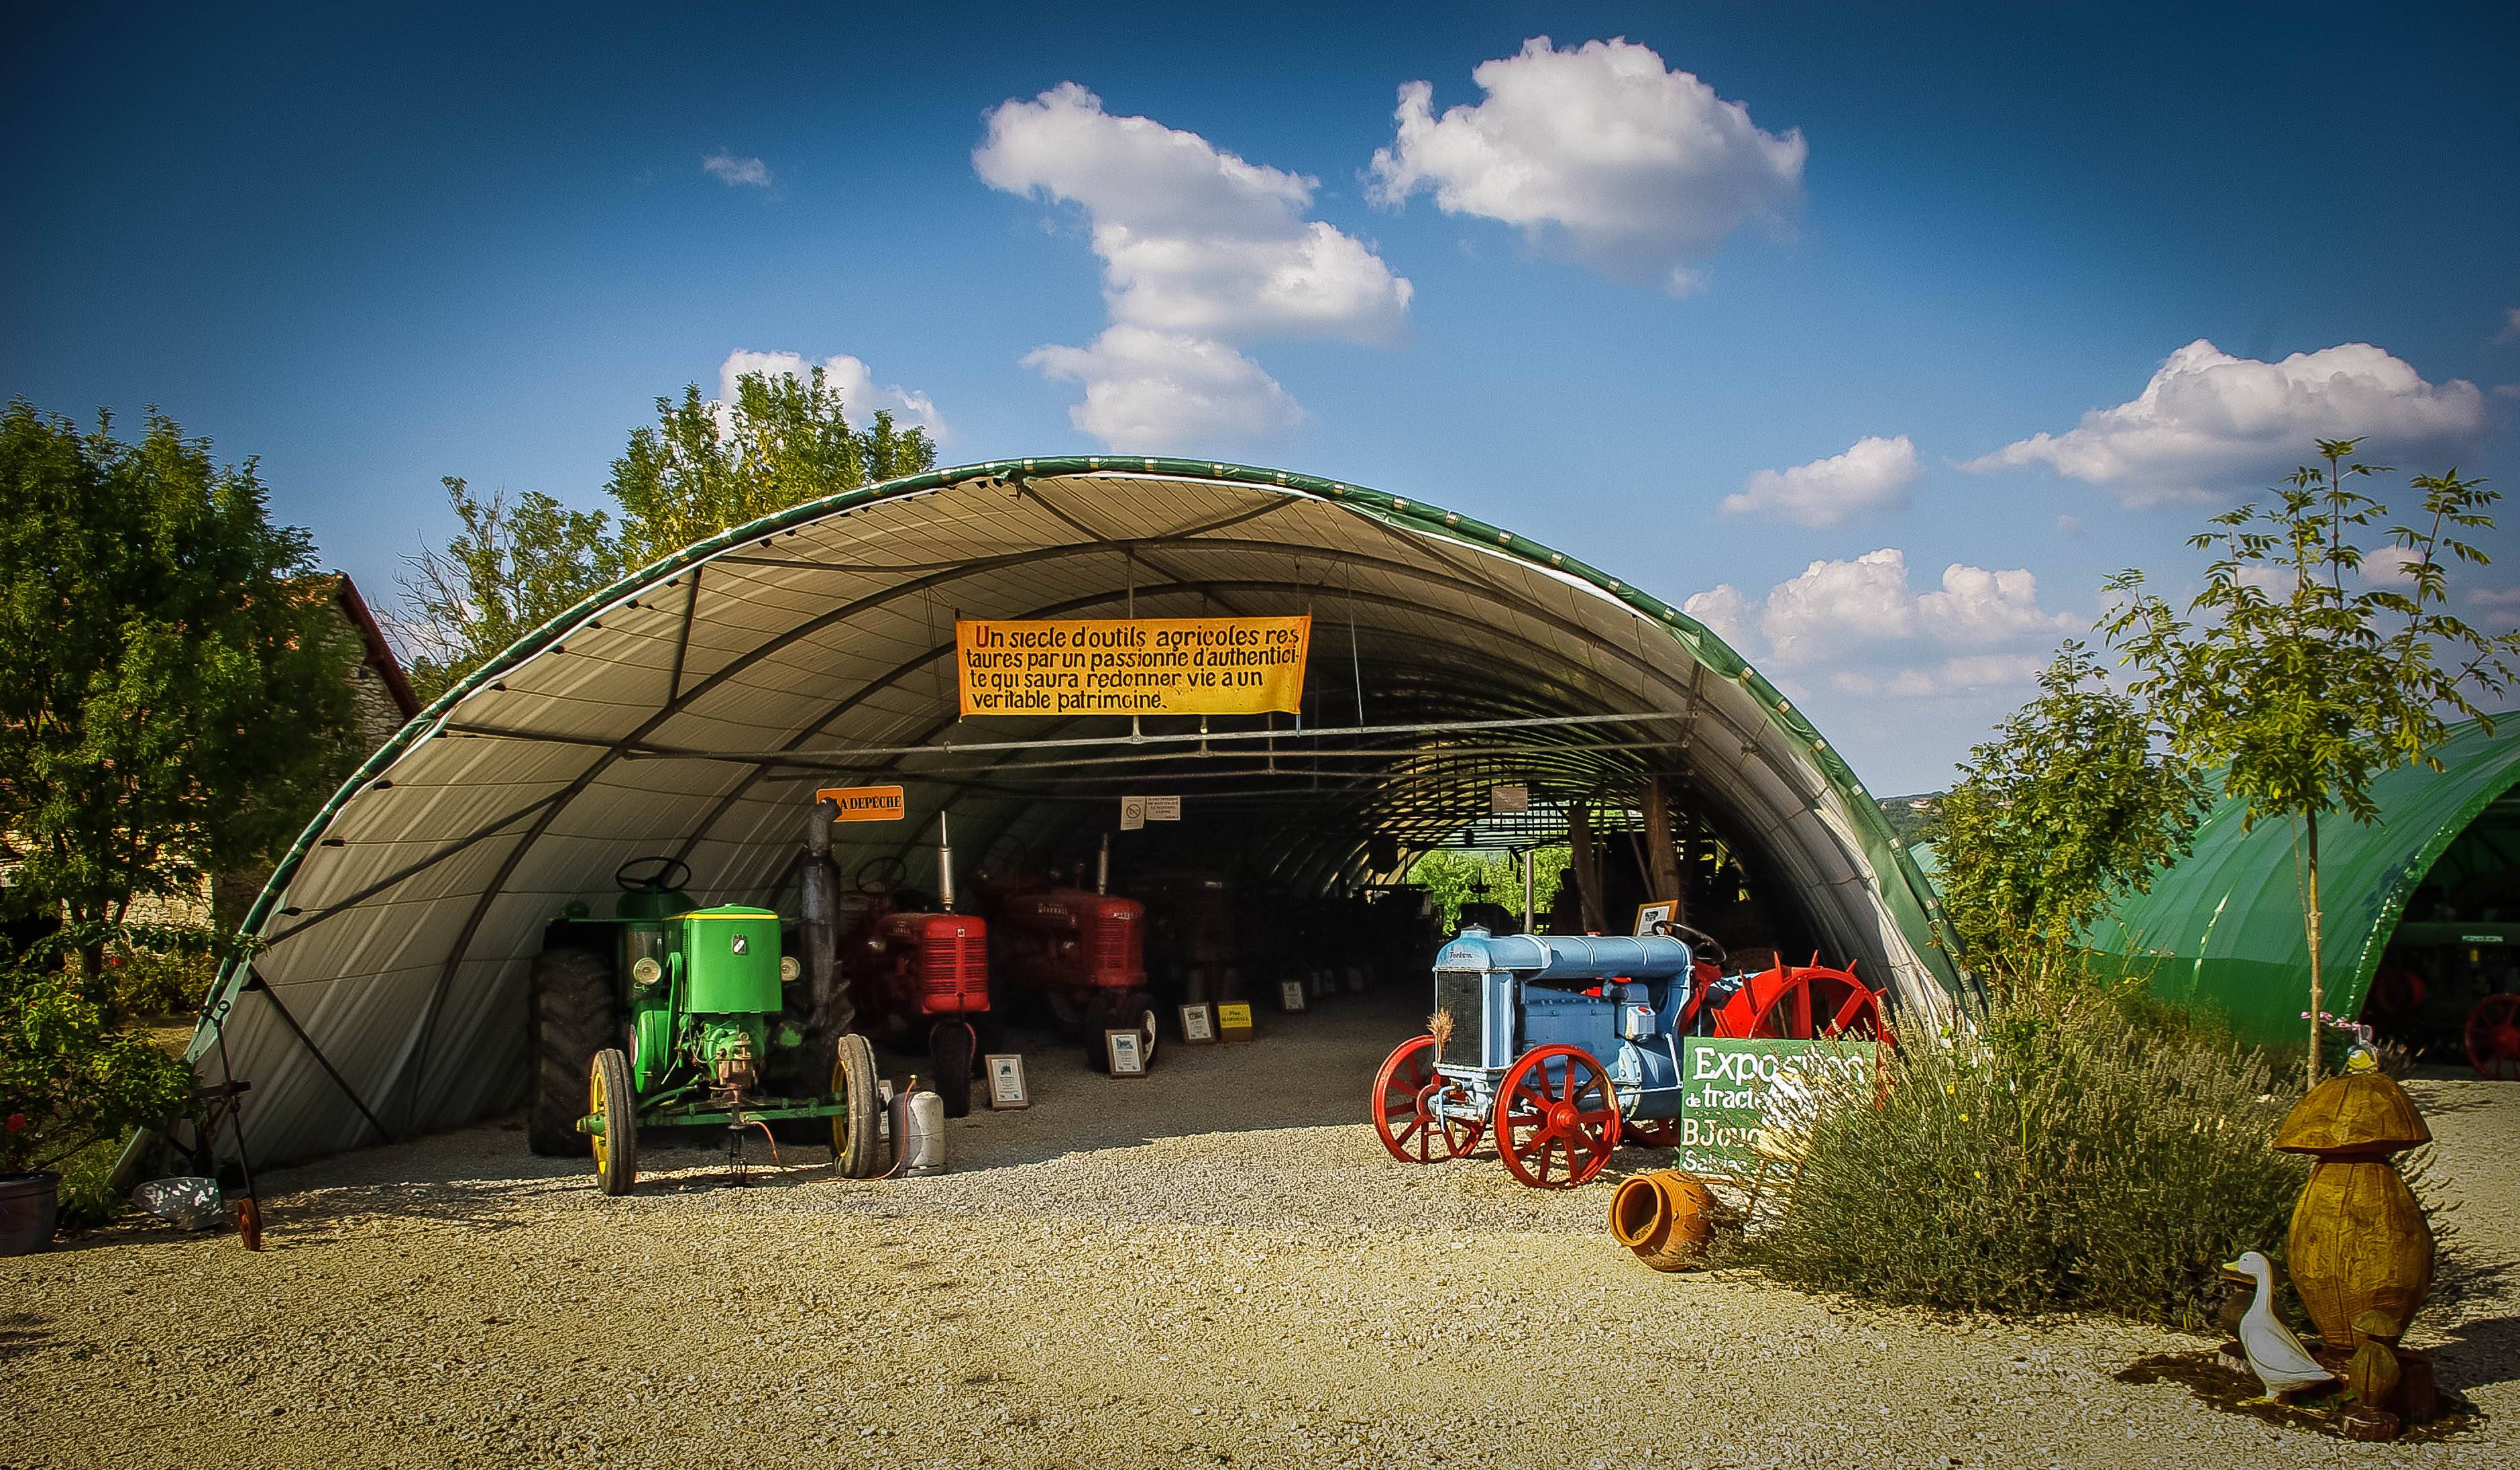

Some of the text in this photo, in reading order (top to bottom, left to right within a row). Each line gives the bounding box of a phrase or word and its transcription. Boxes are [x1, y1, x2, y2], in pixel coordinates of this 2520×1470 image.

[976, 625, 1004, 647] Un
[1009, 627, 1066, 647] siecle
[1072, 625, 1146, 647] d'outils
[1156, 625, 1260, 651] agricoles
[966, 648, 1023, 668] taures
[1027, 651, 1060, 671] par
[1062, 652, 1085, 668] un
[1091, 647, 1189, 671] passionne
[970, 669, 987, 688] te
[991, 672, 1019, 692] qui
[1024, 672, 1079, 688] saura
[1087, 669, 1182, 688] redonner
[1186, 668, 1215, 687] vie
[1237, 670, 1264, 686] un
[972, 689, 1051, 708] veritable
[1685, 1093, 1702, 1108] de
